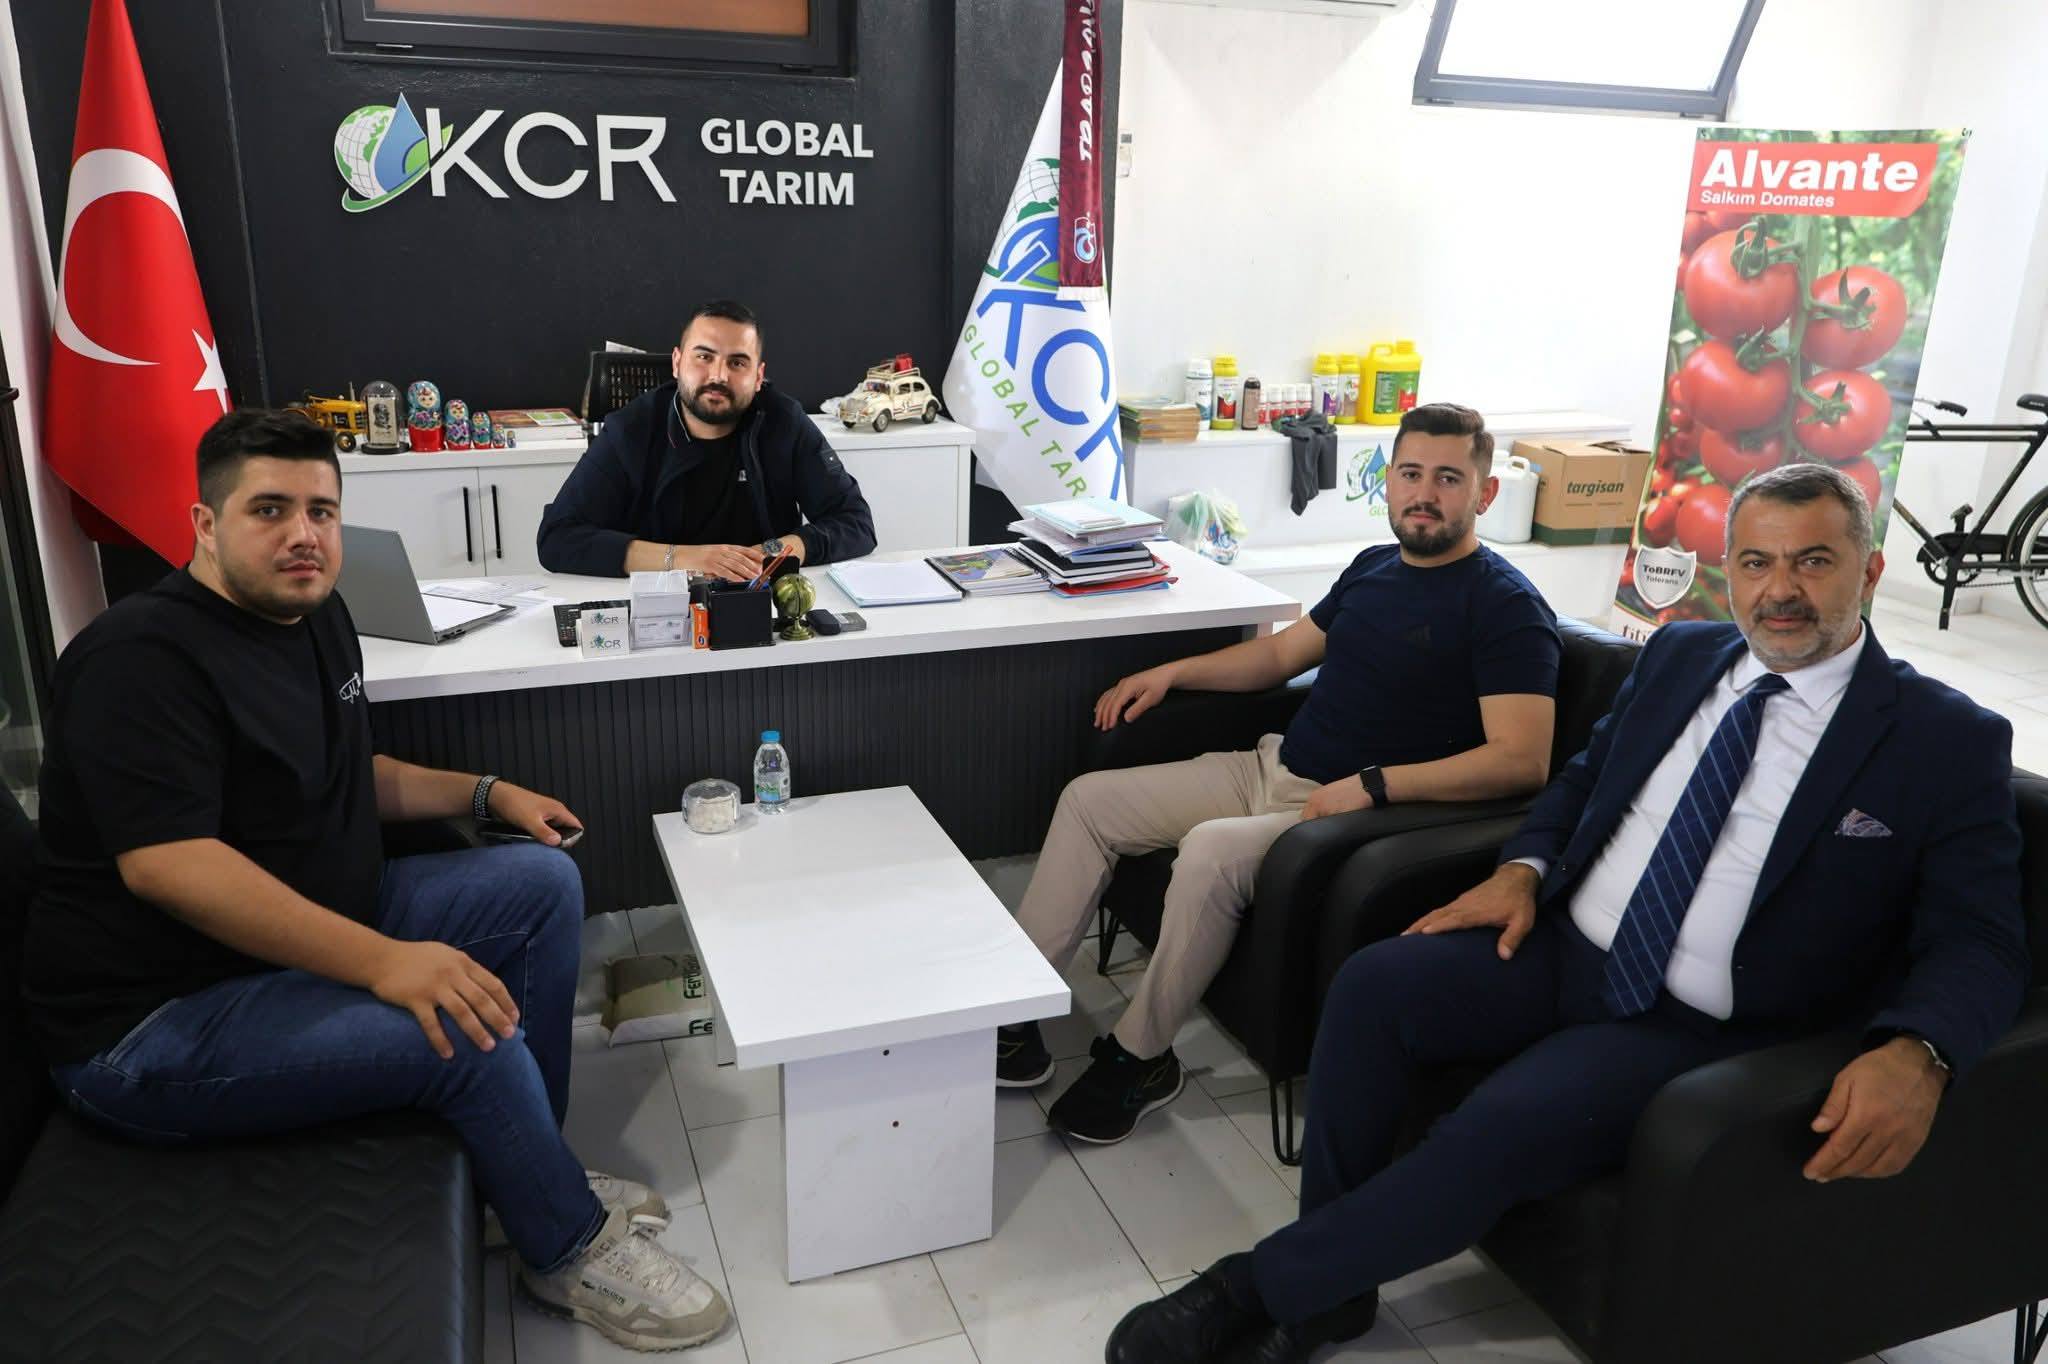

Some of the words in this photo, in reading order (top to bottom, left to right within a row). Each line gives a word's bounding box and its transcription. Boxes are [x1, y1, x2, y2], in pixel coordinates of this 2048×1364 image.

[425, 107, 677, 202] KCR
[701, 118, 874, 159] GLOBAL
[720, 169, 854, 206] TARIM
[1700, 148, 1919, 192] Alvante
[1760, 191, 1835, 208] Domates
[963, 324, 1040, 437] GLOBAL
[1041, 440, 1087, 497] TAR
[1567, 480, 1625, 497] targisan
